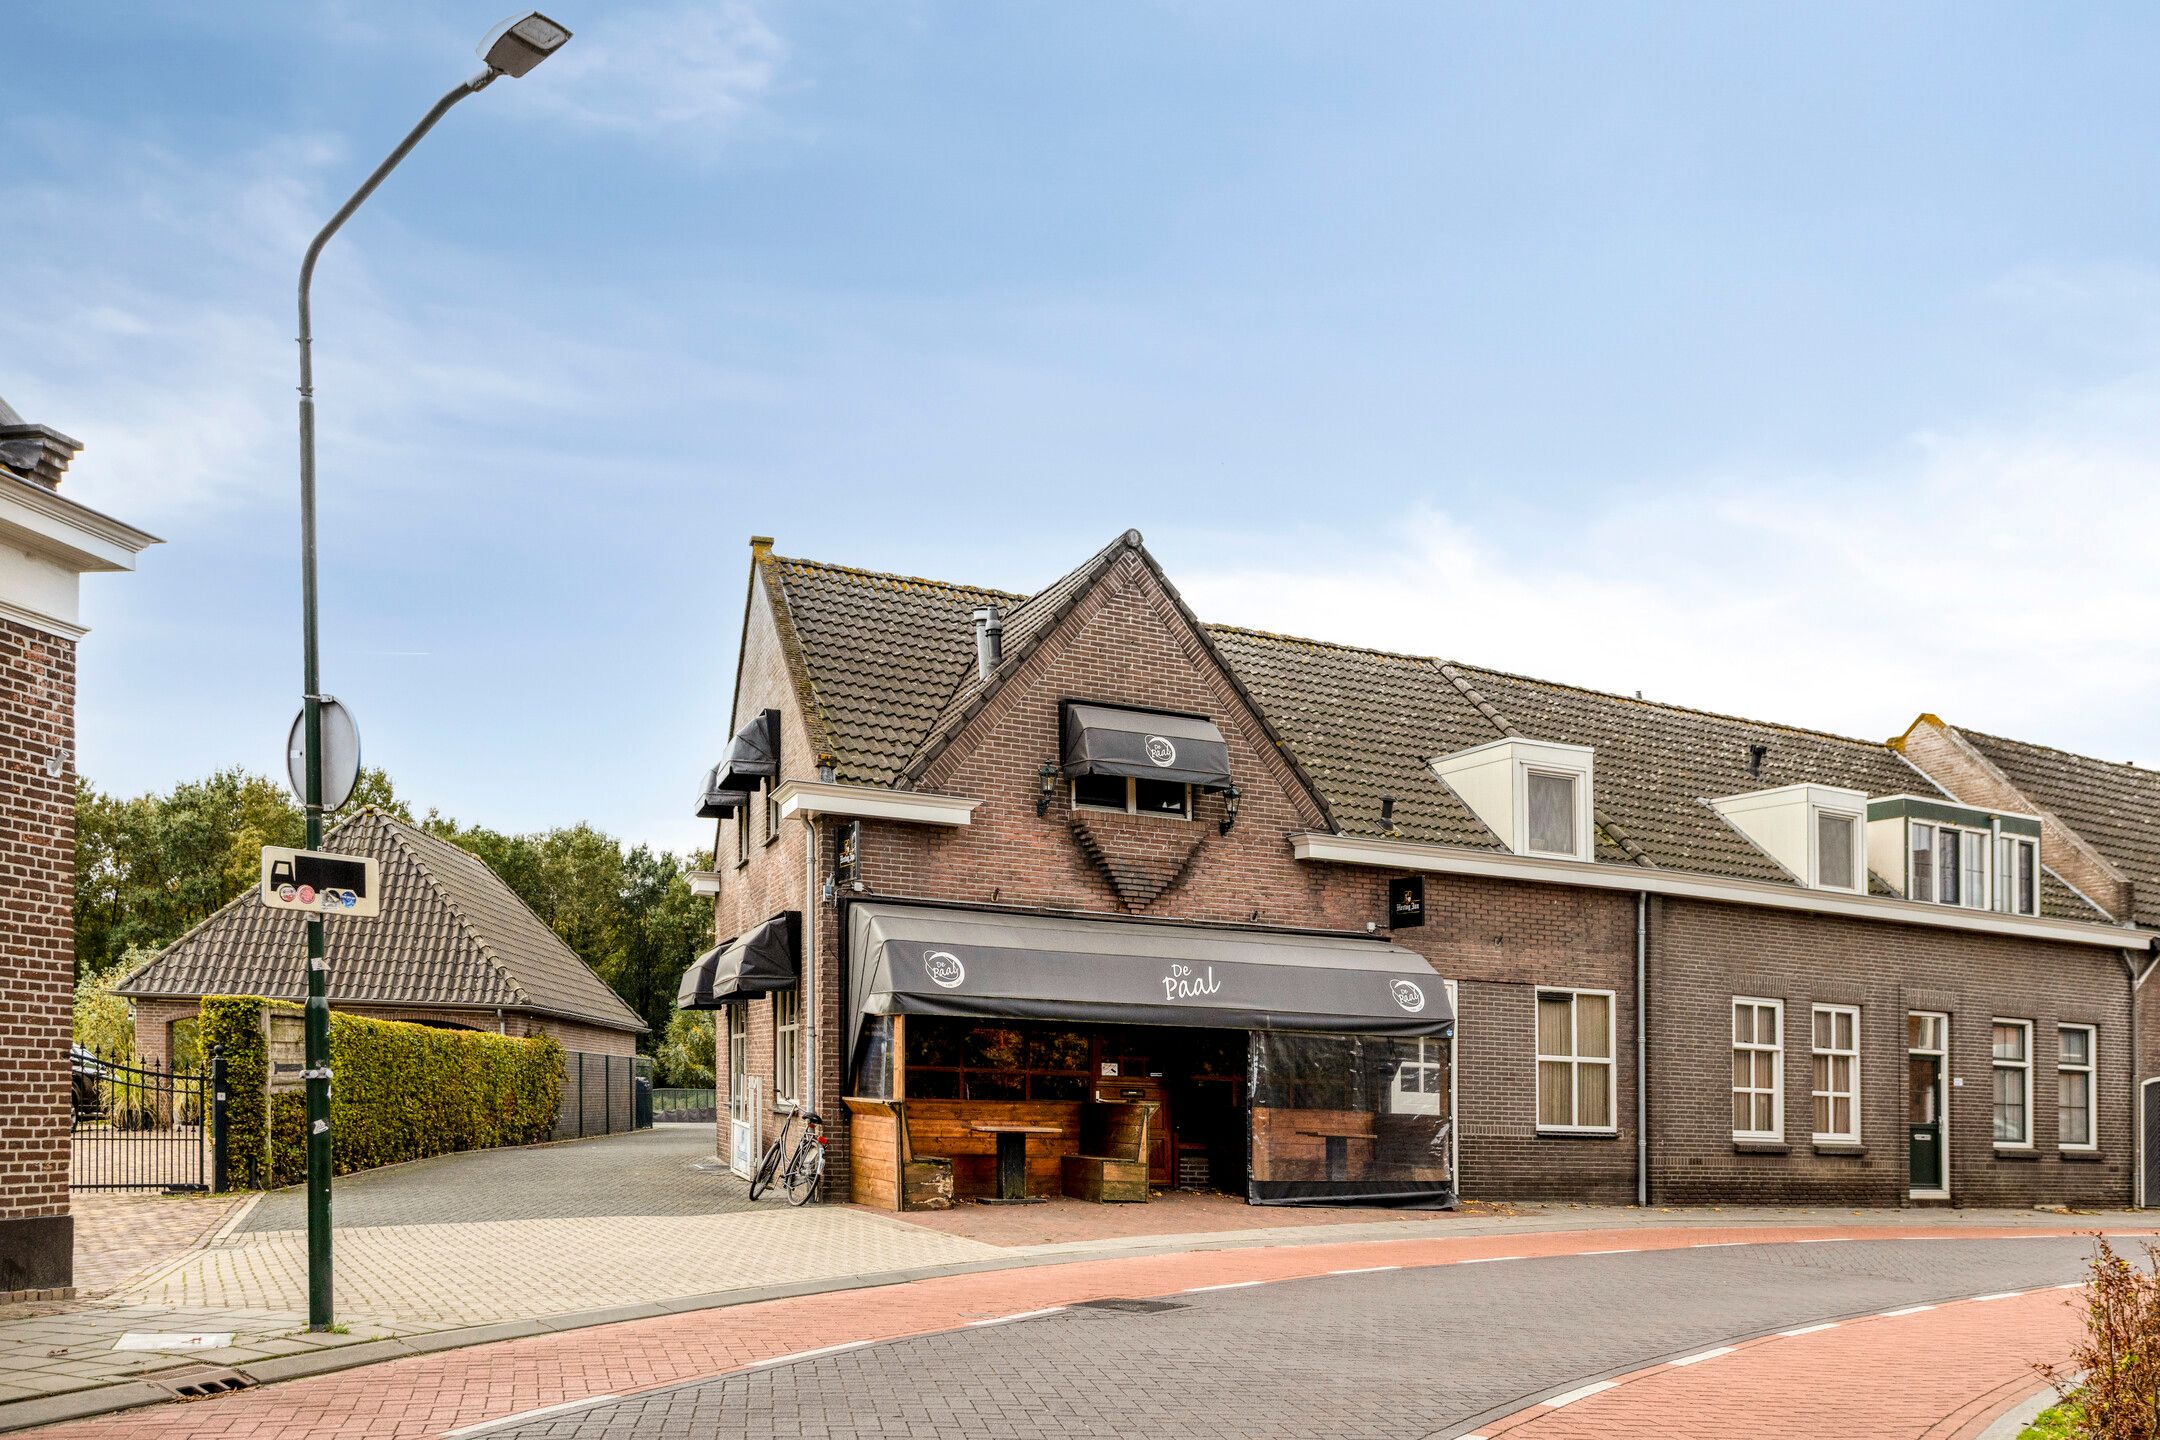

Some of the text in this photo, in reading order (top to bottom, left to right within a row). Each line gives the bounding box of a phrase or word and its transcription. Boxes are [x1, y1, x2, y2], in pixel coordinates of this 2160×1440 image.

[932, 961, 959, 979] Paal
[1171, 964, 1192, 977] De
[1162, 966, 1221, 1000] Paal
